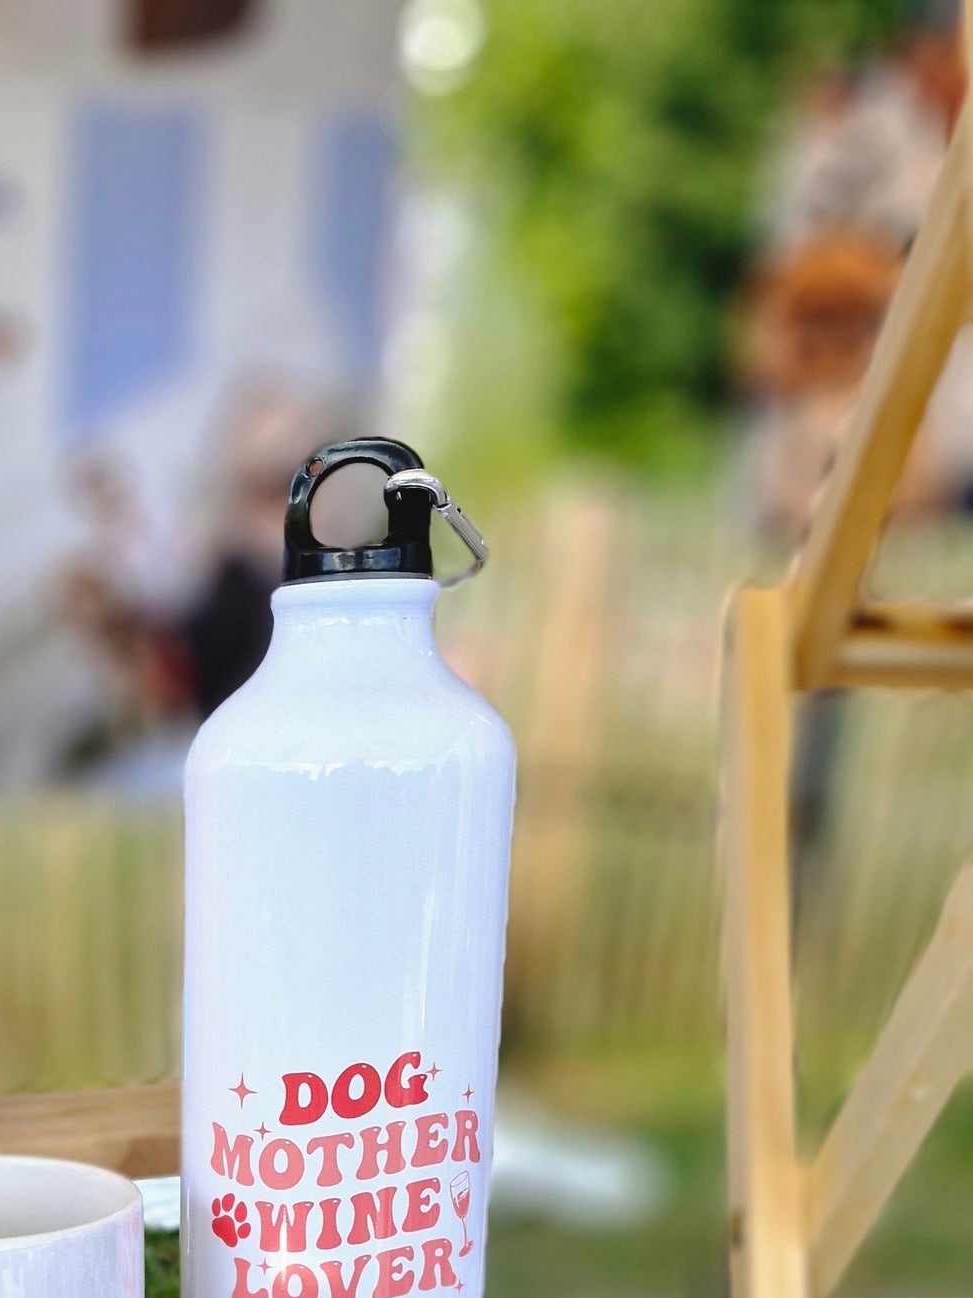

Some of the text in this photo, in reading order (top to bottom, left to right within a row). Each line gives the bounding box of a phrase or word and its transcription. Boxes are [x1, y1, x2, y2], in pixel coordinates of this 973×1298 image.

[279, 1051, 429, 1126] DOG
[210, 1110, 480, 1190] MOTHER
[255, 1177, 441, 1252] WINE
